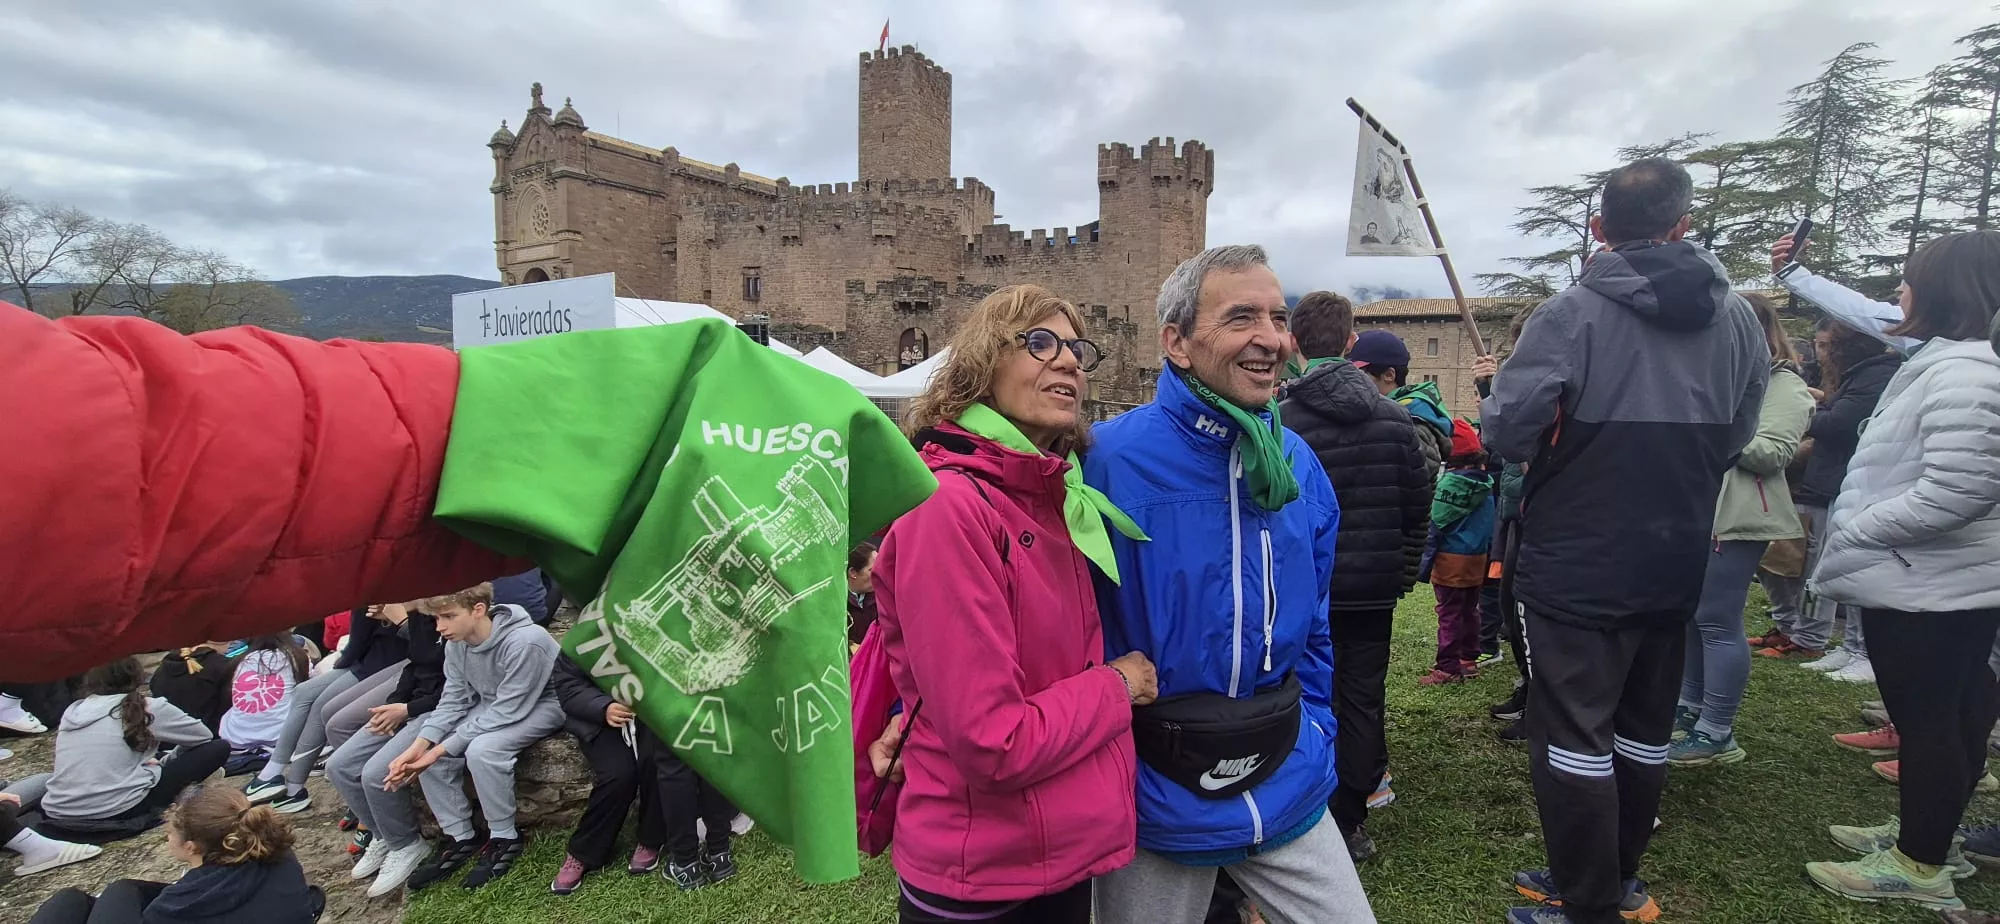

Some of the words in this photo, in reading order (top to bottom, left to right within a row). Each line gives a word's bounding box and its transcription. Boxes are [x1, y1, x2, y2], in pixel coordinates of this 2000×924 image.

[494, 299, 572, 337] Javieradas
[1195, 414, 1229, 439] HH
[701, 420, 849, 488] HUESCA
[575, 572, 644, 707] SALE
[673, 696, 733, 755] A
[1211, 753, 1260, 776] NIKE
